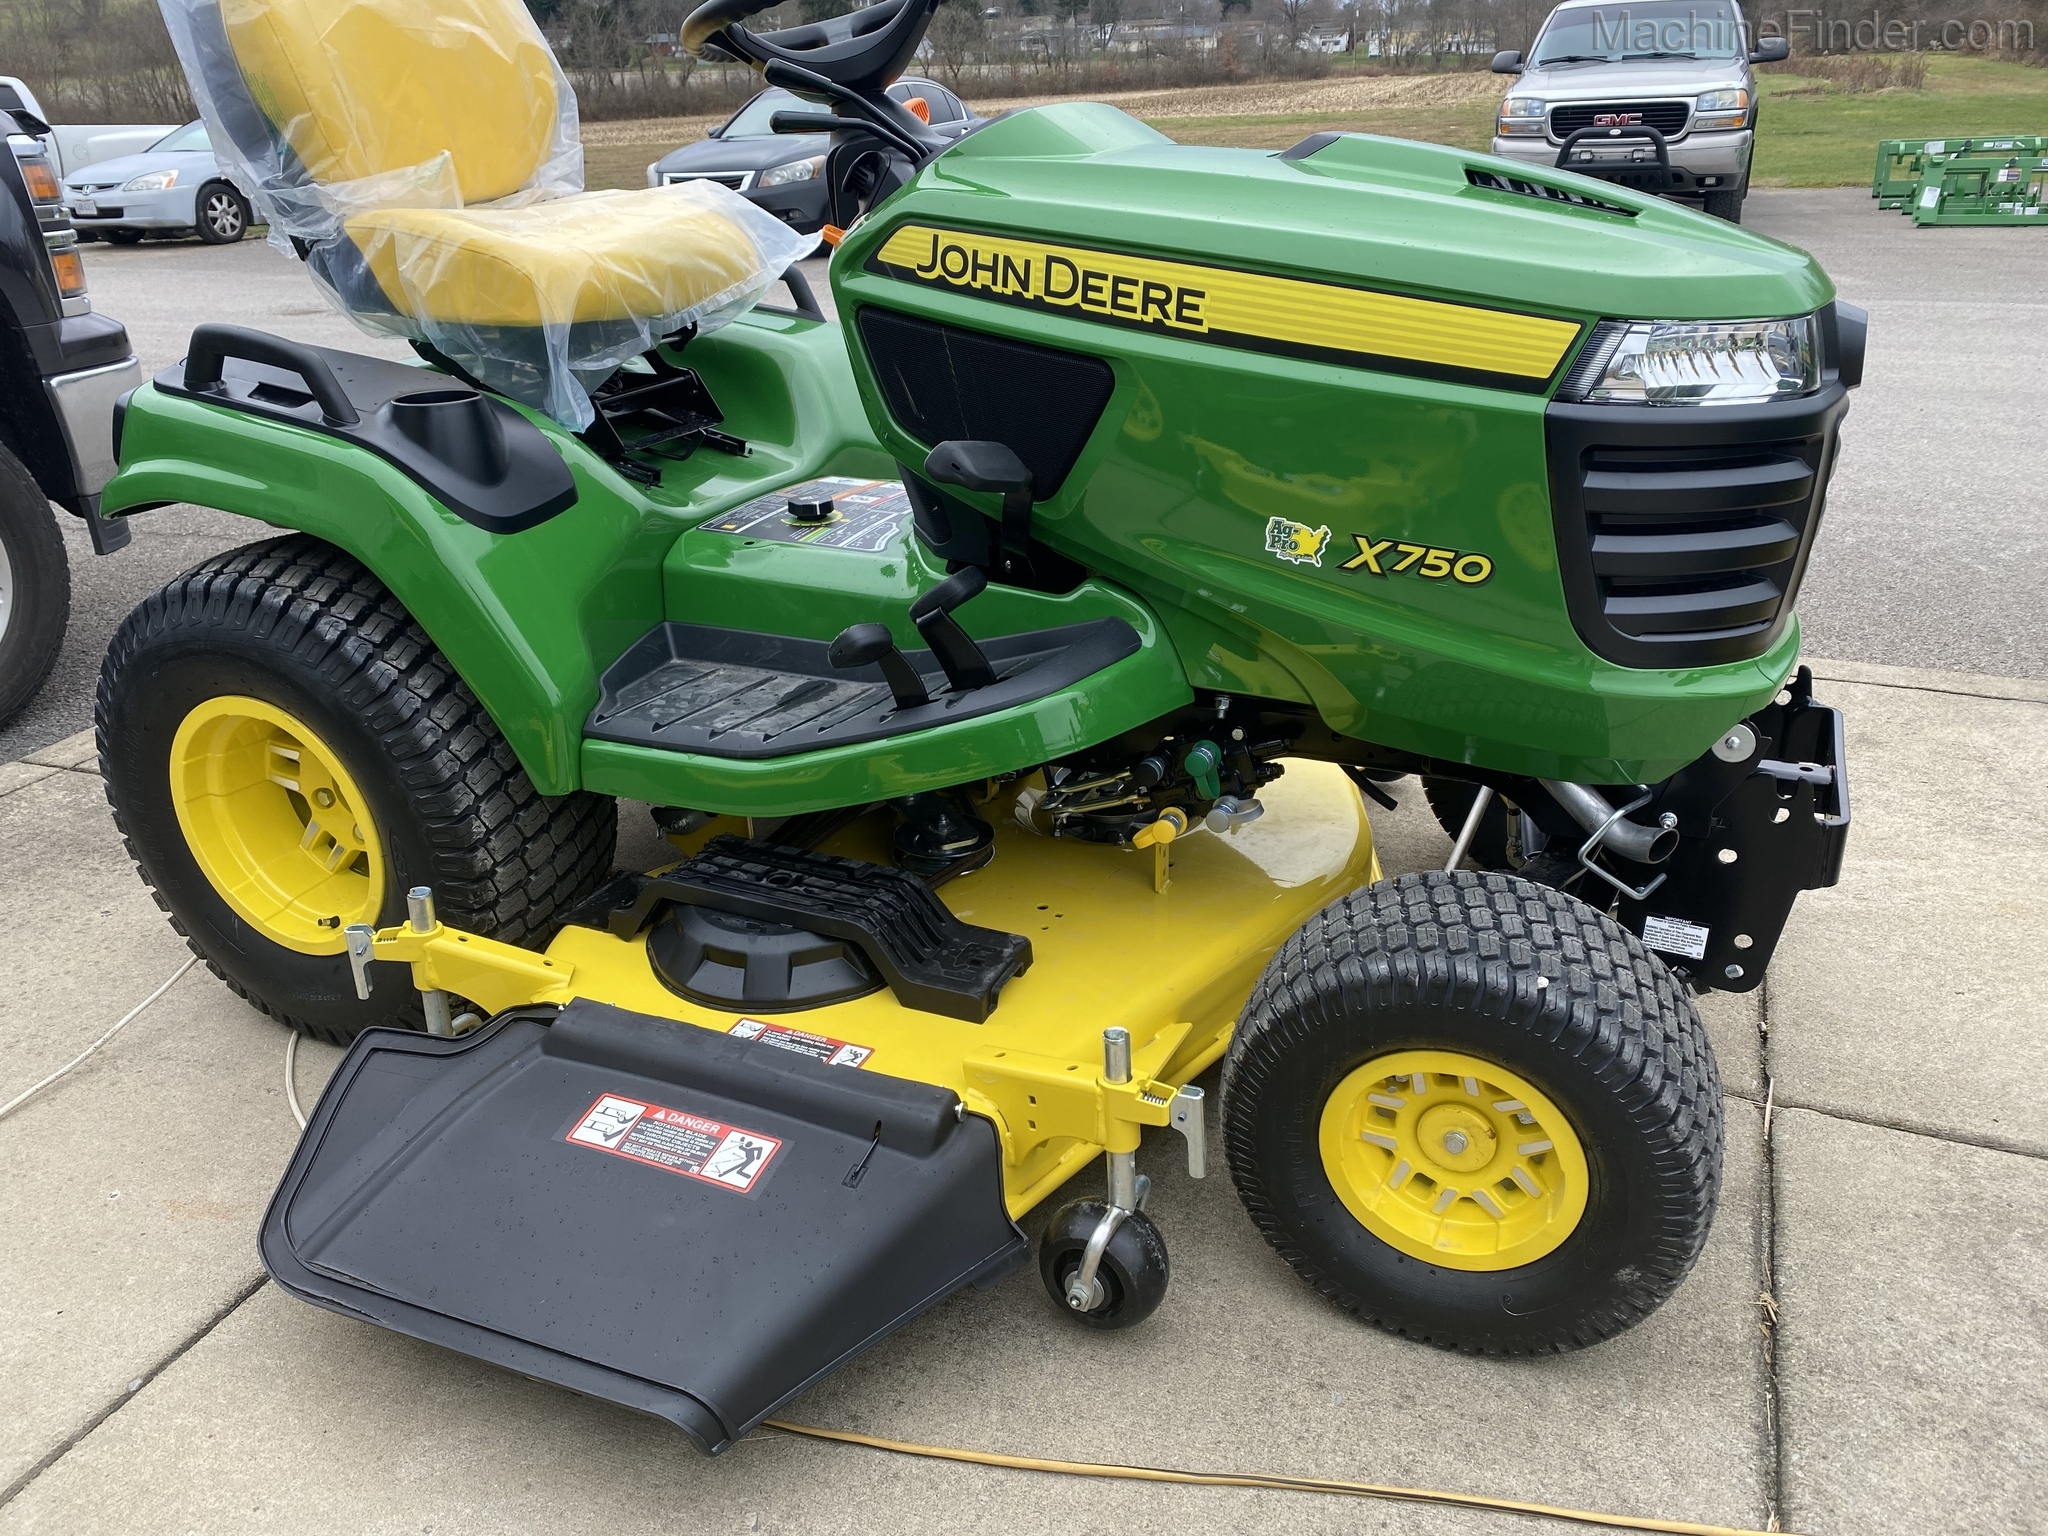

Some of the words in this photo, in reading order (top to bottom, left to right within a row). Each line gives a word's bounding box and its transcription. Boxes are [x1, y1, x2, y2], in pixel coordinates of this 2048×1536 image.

[1594, 113, 1643, 126] GMC
[916, 234, 1034, 296] JOHN
[1044, 254, 1208, 329] DEERE
[1269, 534, 1299, 551] Pro
[1342, 534, 1494, 584] X750
[792, 1031, 828, 1043] DANGER
[653, 1121, 686, 1133] ROTATING
[685, 1129, 708, 1139] BLADE
[667, 1113, 720, 1134] DANGER
